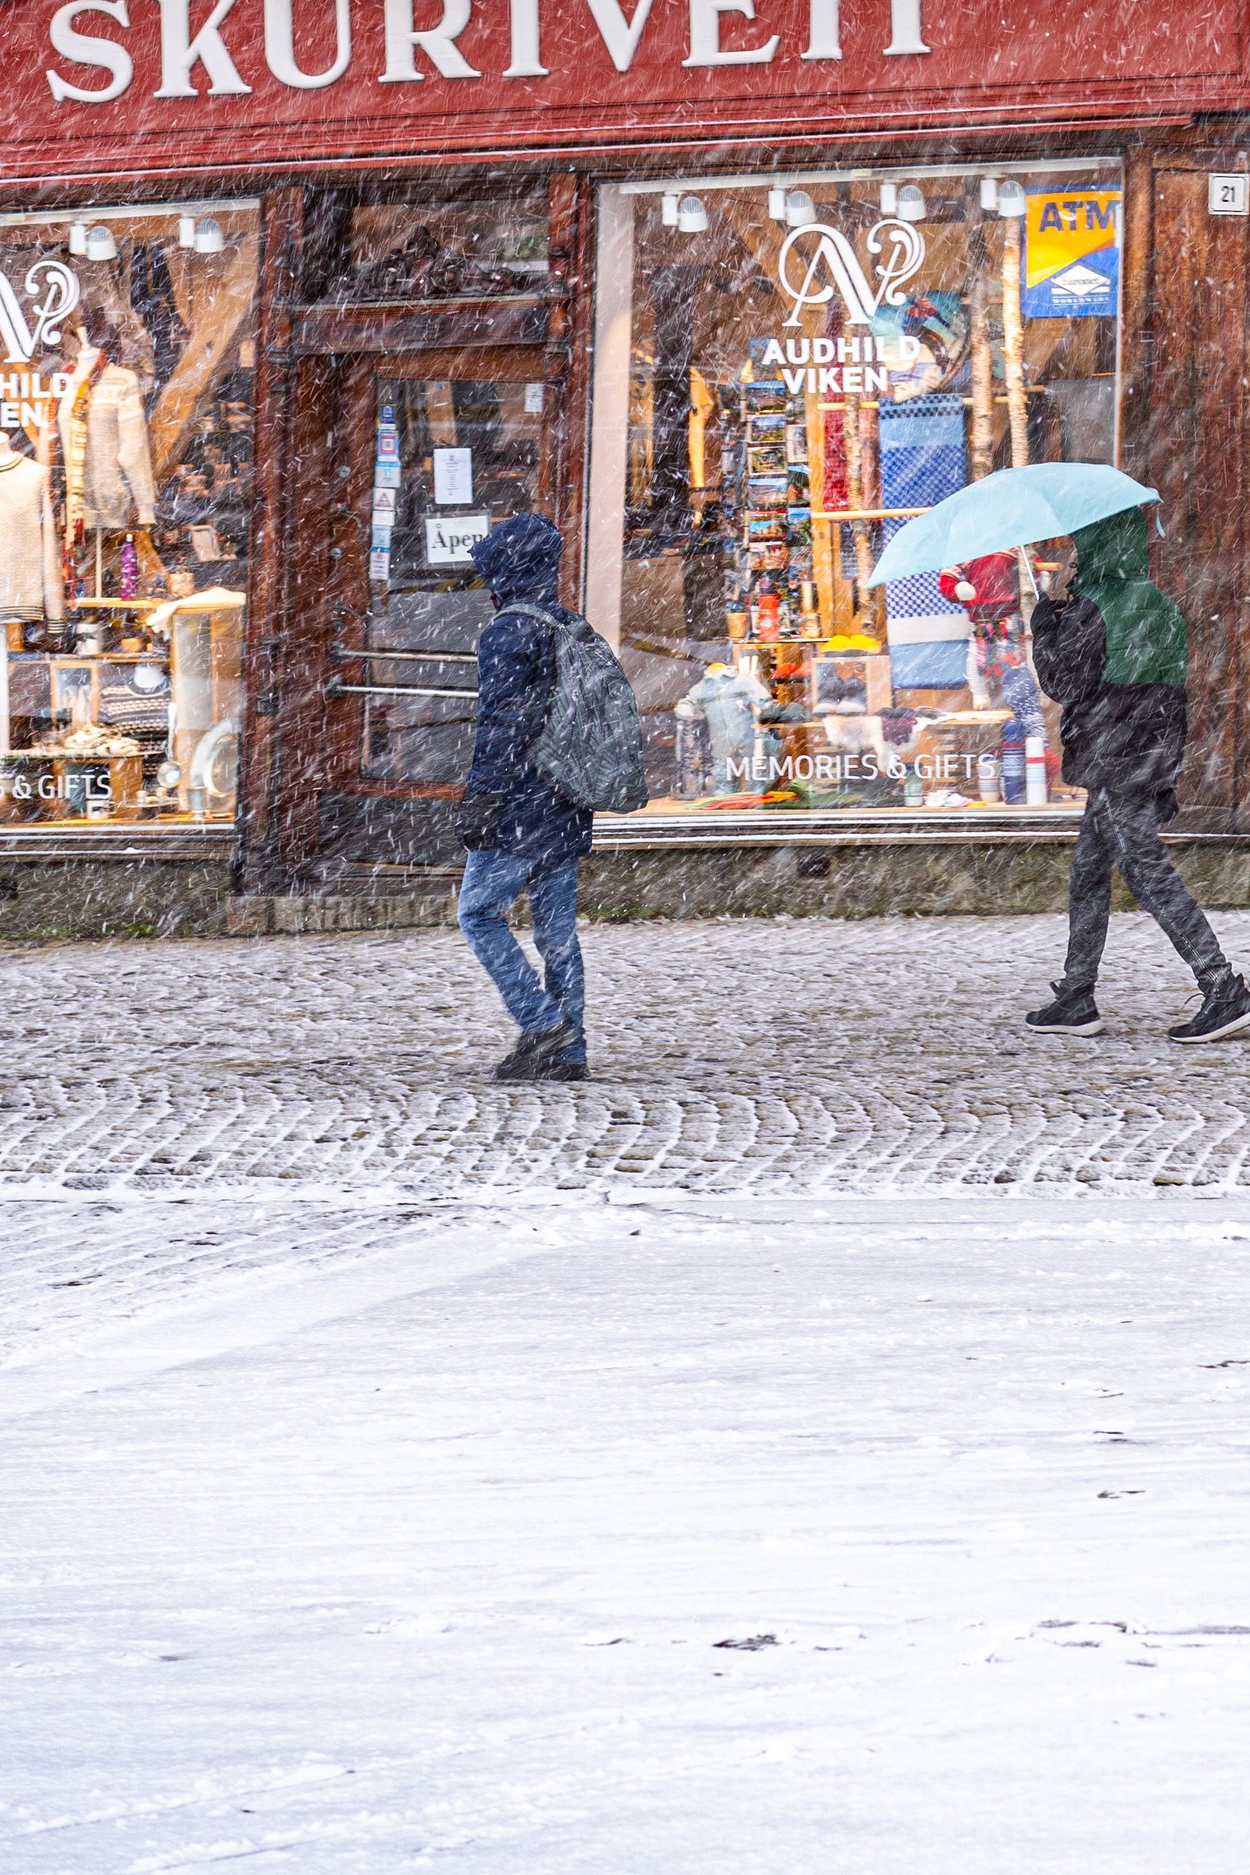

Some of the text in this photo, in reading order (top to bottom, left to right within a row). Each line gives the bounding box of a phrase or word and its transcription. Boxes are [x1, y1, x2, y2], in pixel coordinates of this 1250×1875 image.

[1221, 186, 1236, 203] 21
[1039, 199, 1120, 232] ATM
[761, 335, 922, 366] AUDHILD
[781, 366, 889, 395] VIKEN
[726, 752, 996, 782] MEMORIES & GIFTS
[12, 774, 32, 800] &
[38, 774, 113, 800] GIFTS
